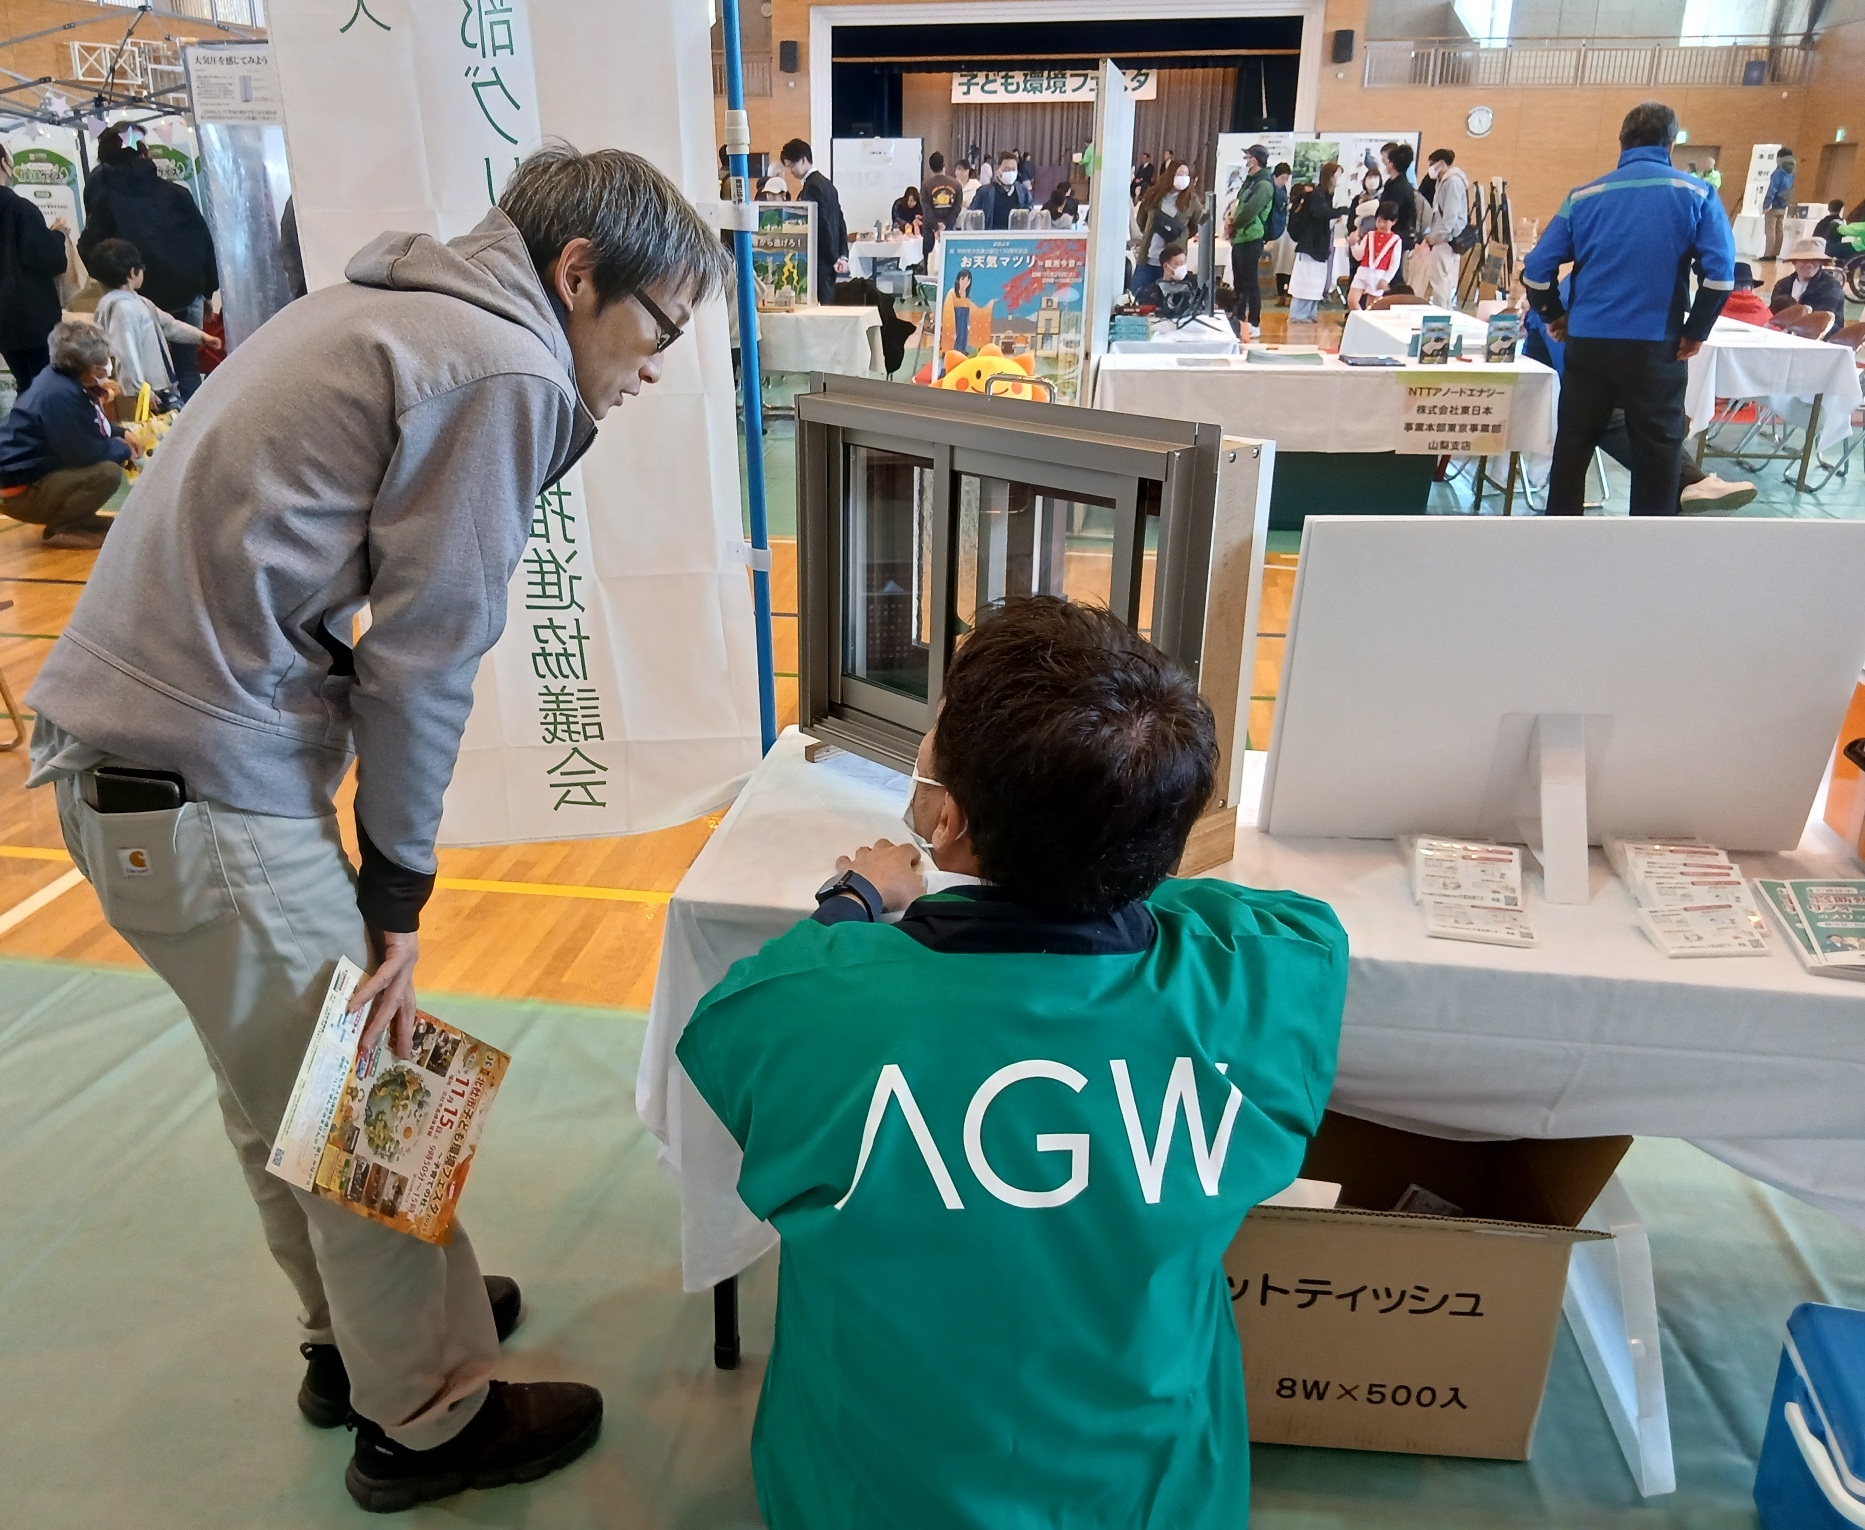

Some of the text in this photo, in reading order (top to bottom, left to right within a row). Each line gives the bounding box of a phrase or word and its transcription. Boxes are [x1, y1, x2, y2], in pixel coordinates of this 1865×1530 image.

[958, 71, 1150, 95] 子ども環境フェタ
[960, 255, 1036, 268] お天気マツリ
[1408, 387, 1505, 398] NTTアノードエナジー
[1417, 404, 1493, 415] 株式会社東日本
[1404, 422, 1502, 433] 事業本部東京事業部
[1428, 441, 1471, 451] 山梨支店
[1275, 1377, 1468, 1410] 8W×500入
